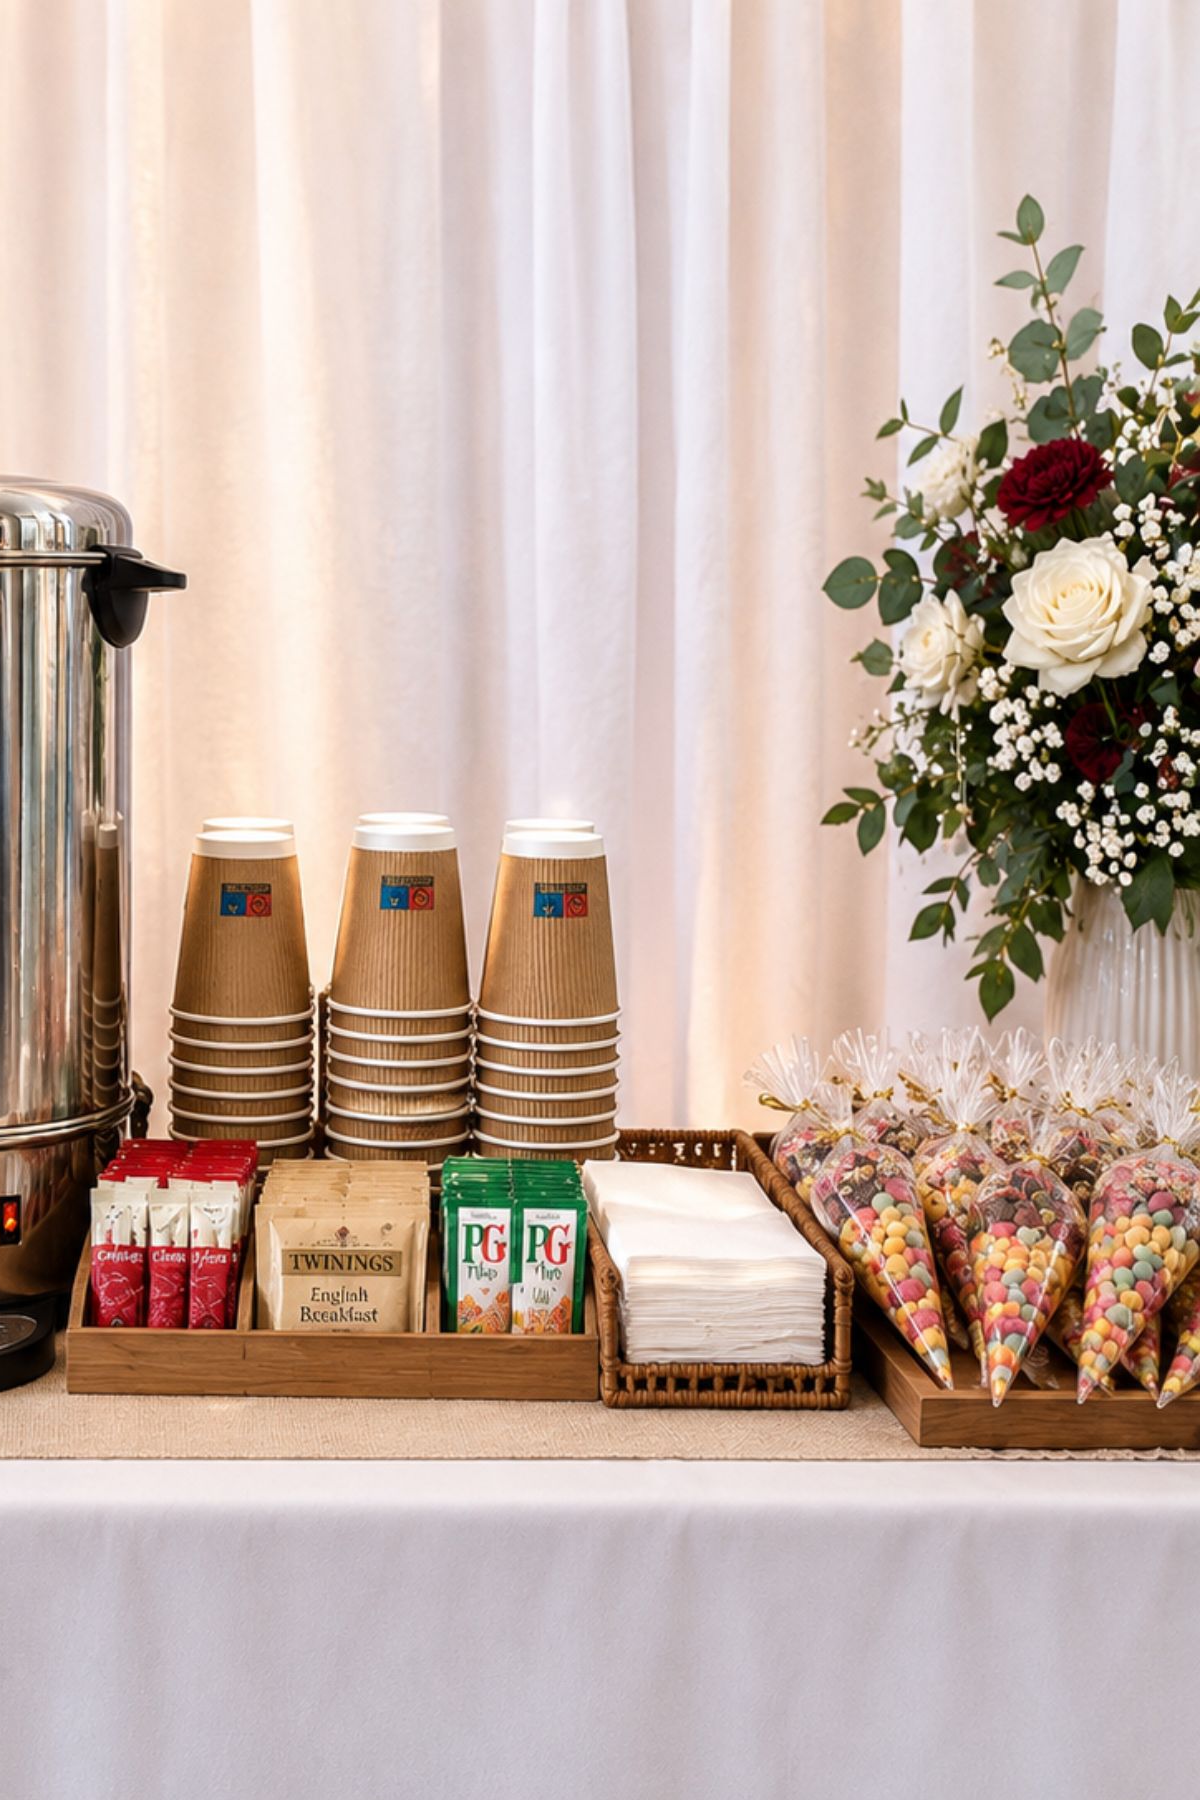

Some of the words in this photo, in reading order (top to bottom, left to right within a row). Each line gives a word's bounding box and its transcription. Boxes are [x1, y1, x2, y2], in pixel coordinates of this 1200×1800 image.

[289, 1253, 394, 1272] TWININGS
[461, 1223, 507, 1263] PG
[525, 1224, 572, 1265] PG
